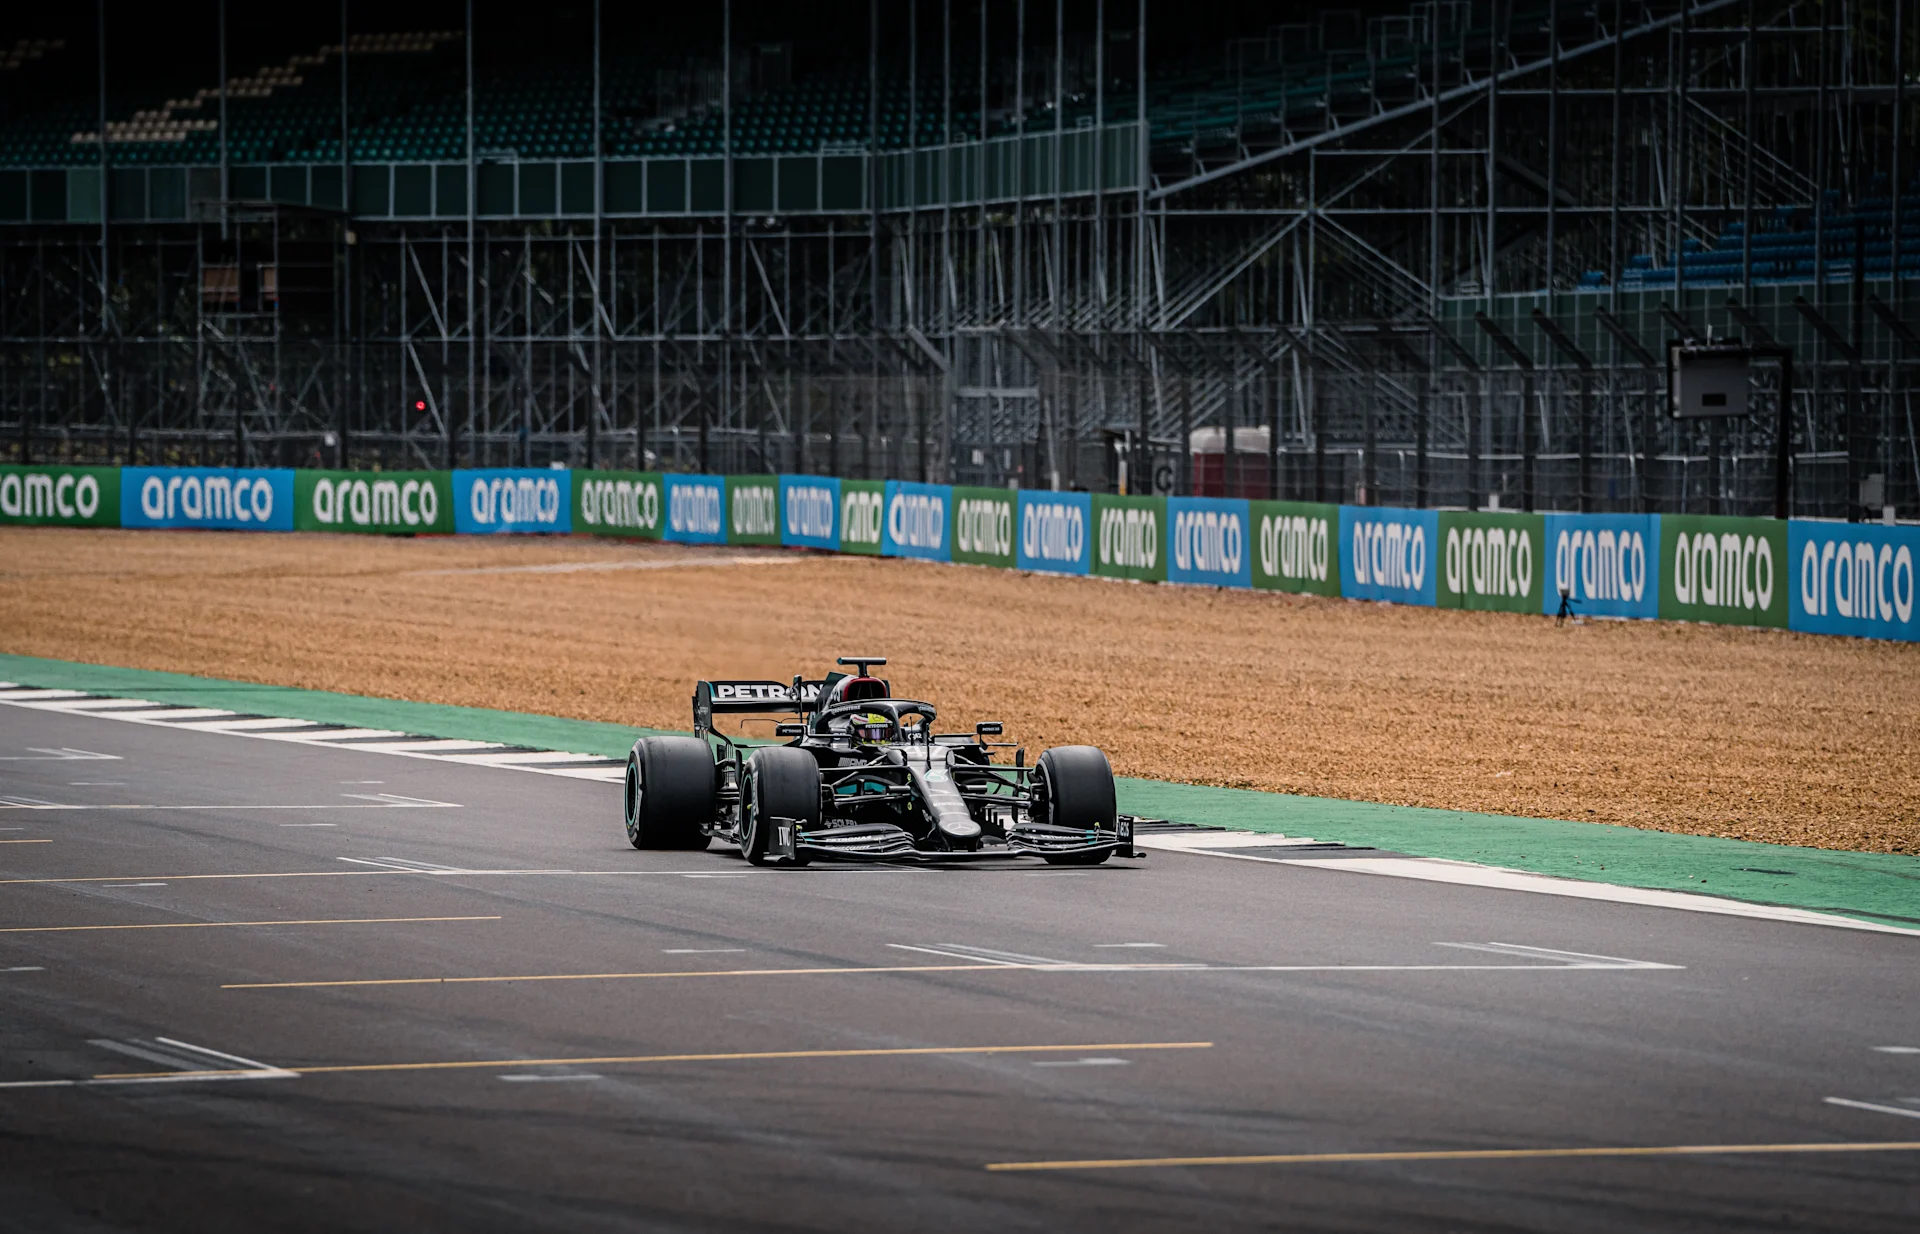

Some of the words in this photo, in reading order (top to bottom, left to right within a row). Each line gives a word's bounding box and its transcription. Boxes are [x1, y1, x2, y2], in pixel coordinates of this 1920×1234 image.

[0, 474, 99, 518] amco
[141, 476, 273, 521] aramco
[313, 478, 438, 525] aramco
[470, 477, 560, 524] aramco
[581, 479, 658, 529] aramco
[1023, 503, 1083, 562] aramco
[1099, 508, 1157, 569] aramco
[1174, 511, 1242, 574] aramco
[1260, 515, 1328, 582] aramco
[1353, 521, 1425, 591] aramco
[1446, 527, 1532, 598] aramco
[1556, 530, 1645, 602] aramco
[1674, 531, 1773, 611] aramco
[1801, 539, 1913, 623] aramco
